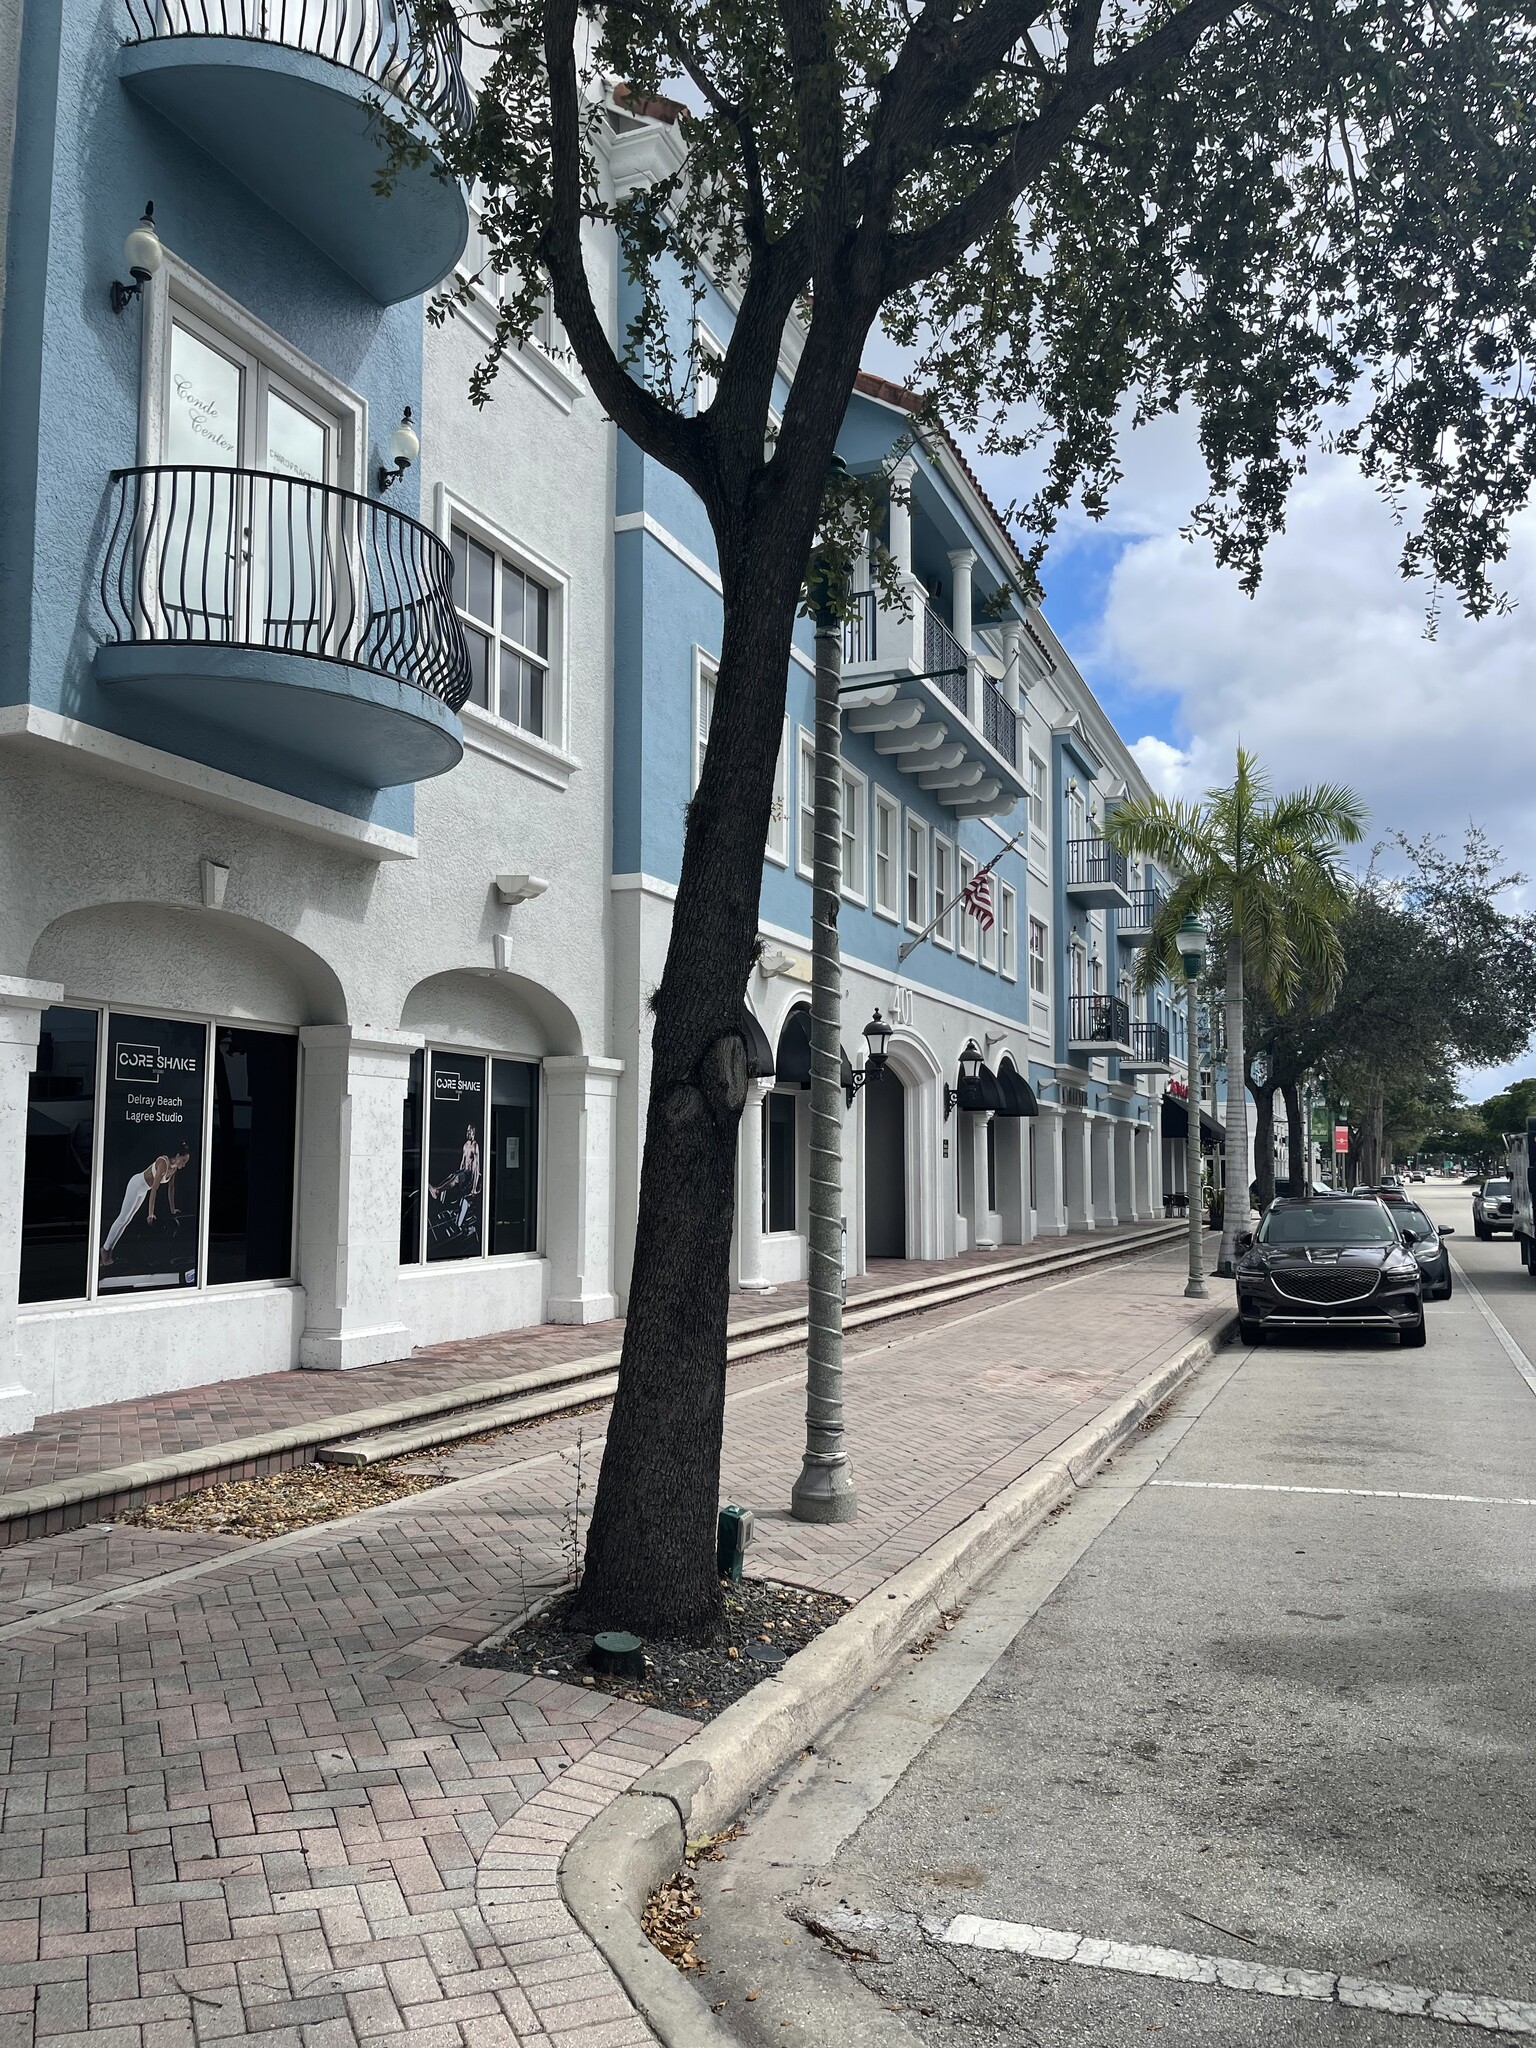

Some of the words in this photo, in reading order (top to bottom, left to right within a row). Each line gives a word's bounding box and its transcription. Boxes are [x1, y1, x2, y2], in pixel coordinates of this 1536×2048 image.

[174, 374, 218, 418] Conde
[189, 408, 235, 452] Center
[893, 985, 913, 1025] 401
[119, 1052, 154, 1068] CORE
[156, 1056, 196, 1072] SHAKE
[436, 1078, 457, 1090] CORE
[457, 1080, 481, 1092] SHAKE
[127, 1093, 156, 1107] Delray
[157, 1095, 183, 1107] Beach
[125, 1110, 155, 1123] Lagree
[156, 1111, 183, 1123] Studio
